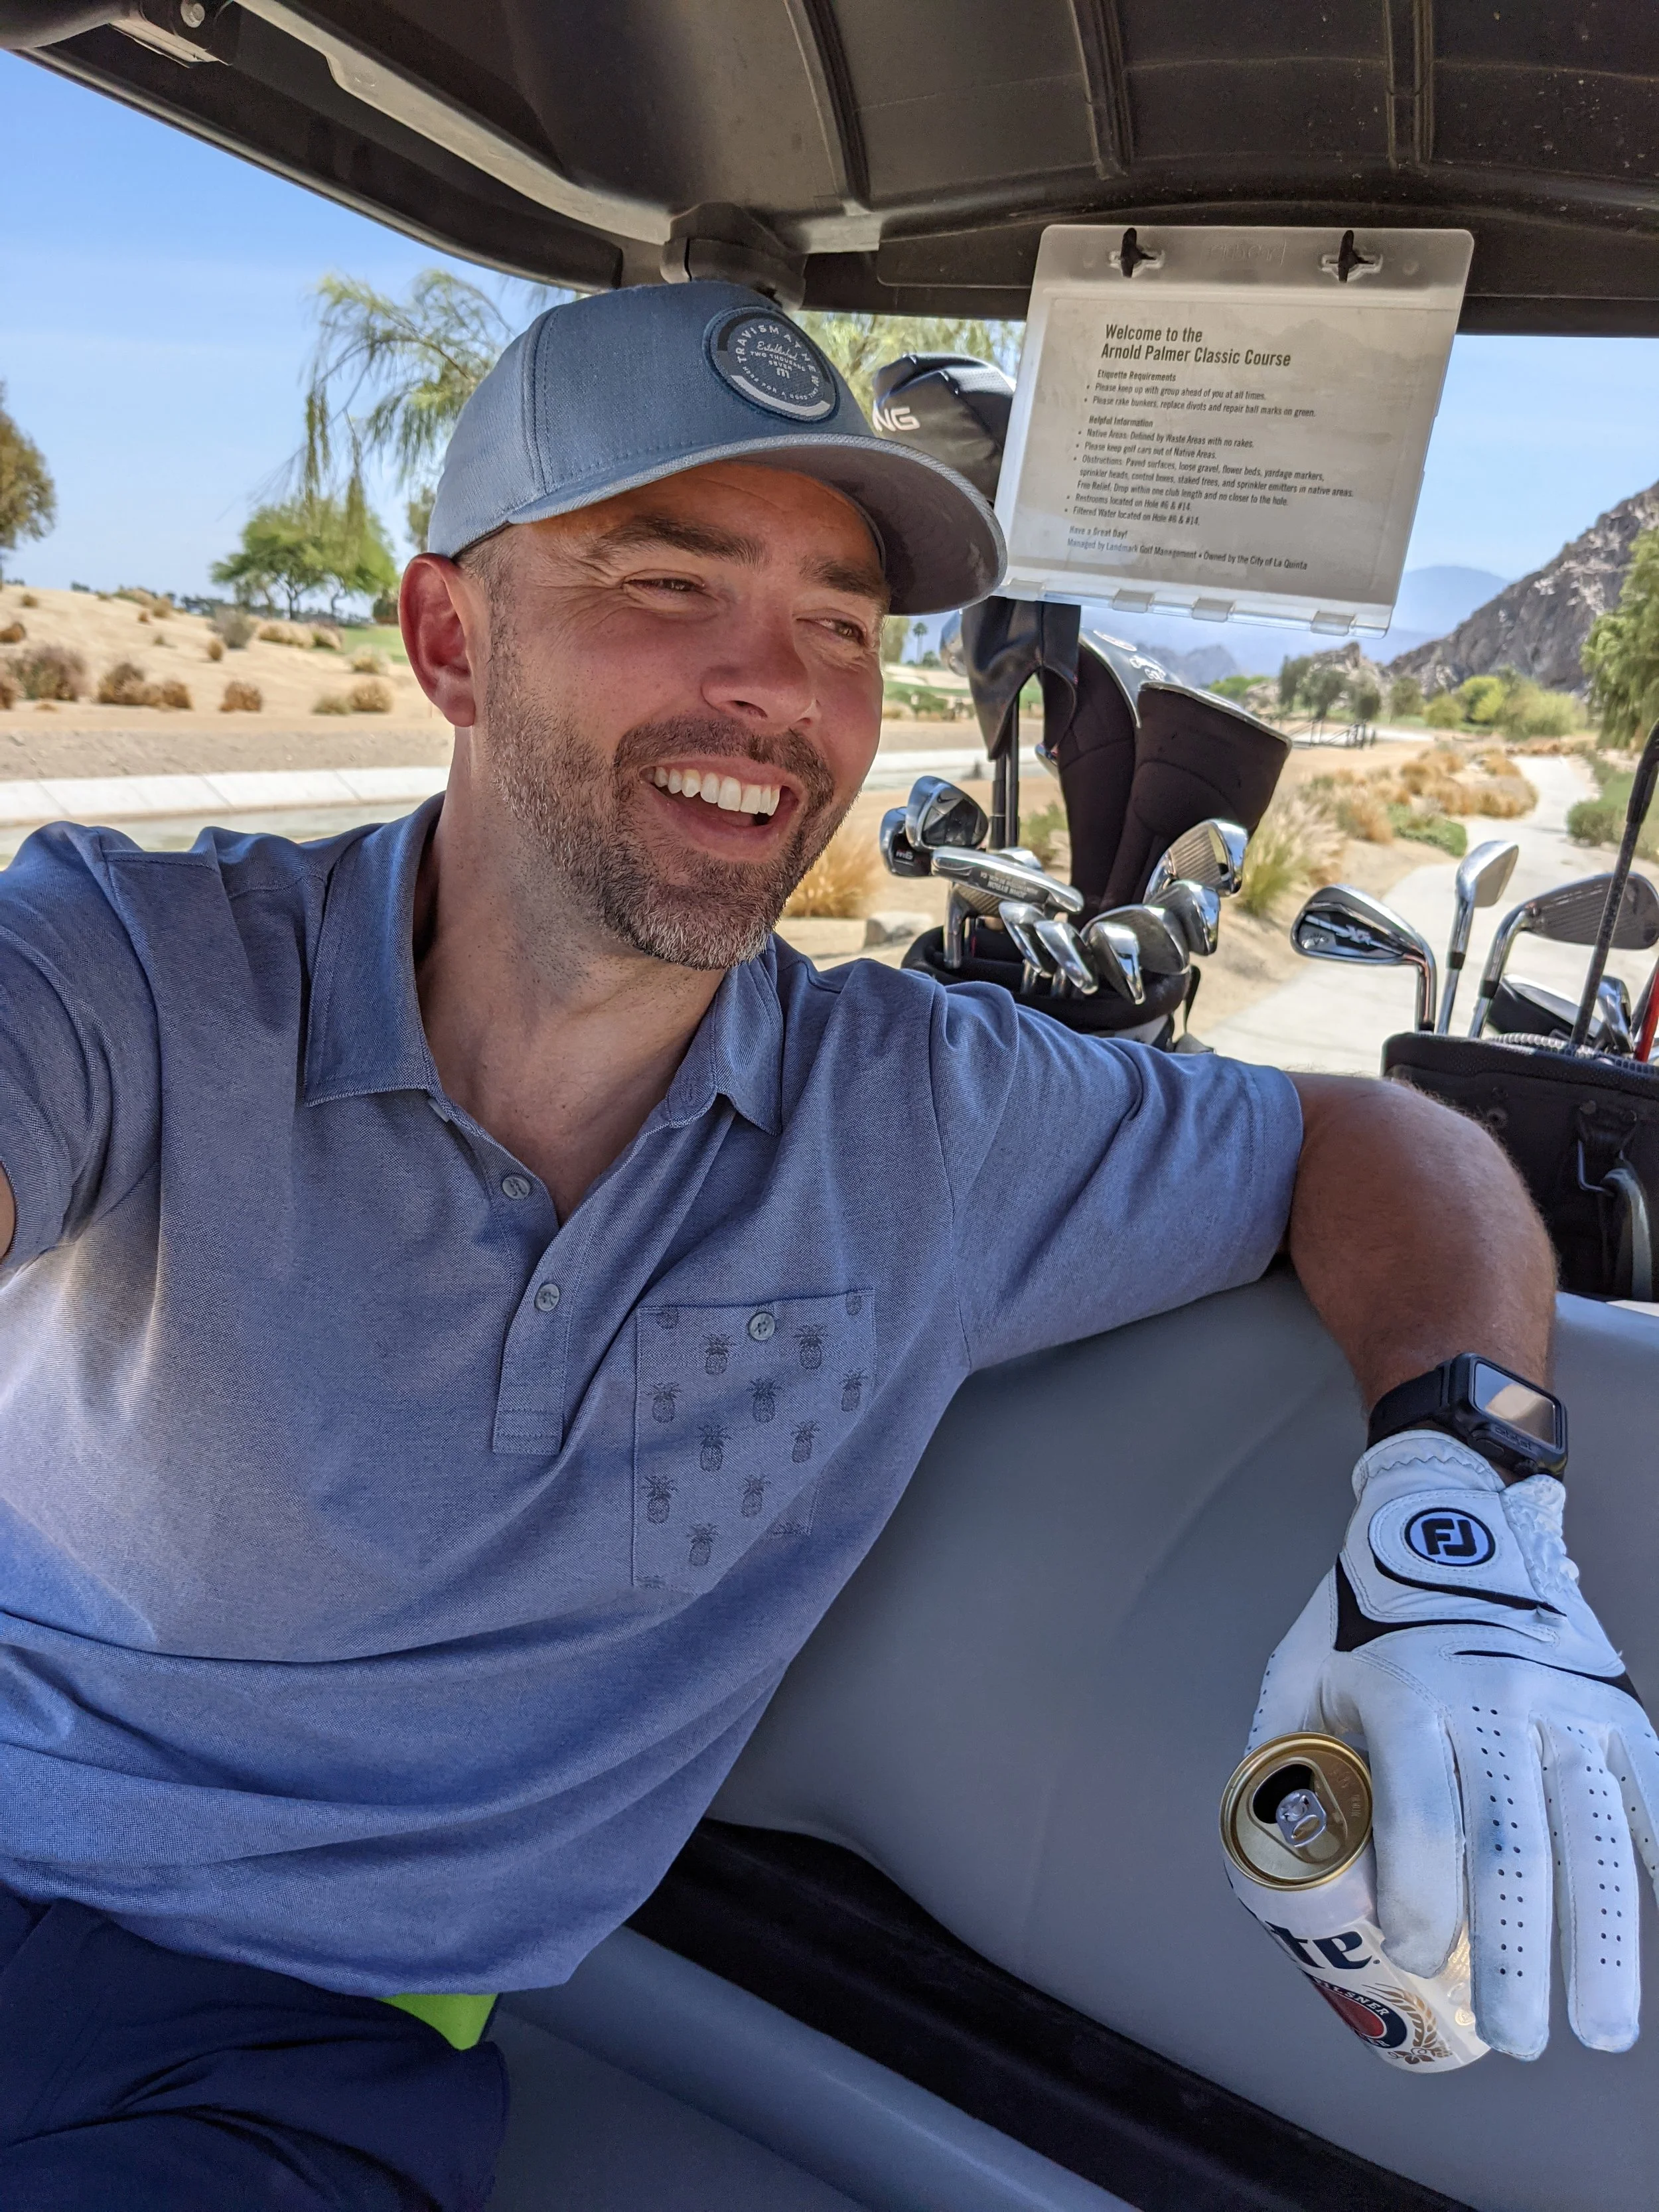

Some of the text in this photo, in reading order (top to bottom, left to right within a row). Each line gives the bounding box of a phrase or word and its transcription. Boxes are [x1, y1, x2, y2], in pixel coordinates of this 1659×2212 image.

[1106, 324, 1202, 342] Welcome to the
[1101, 343, 1291, 366] Arnold Palmer Classic Course
[1098, 369, 1176, 382] Etiquette Requirements
[1095, 383, 1116, 392] Please
[1118, 384, 1133, 394] keep
[1144, 386, 1159, 395] with
[1161, 388, 1179, 397] group
[1181, 388, 1202, 398] ahead
[1203, 388, 1211, 398] of
[1212, 391, 1224, 400] you
[1225, 390, 1233, 399] at
[1234, 390, 1243, 399] all
[1093, 396, 1114, 406] Please
[1115, 397, 1129, 407] rake
[1161, 400, 1185, 409] replace
[1187, 401, 1206, 411] divots
[1208, 403, 1222, 412] and
[1223, 404, 1243, 414] repair
[1245, 405, 1259, 414] ball
[1260, 406, 1281, 415] marks
[1294, 408, 1315, 418] green.
[1088, 415, 1153, 427] Helpful Information
[1087, 429, 1108, 438] Native
[1130, 431, 1155, 441] Defined
[1156, 433, 1165, 443] by
[1165, 433, 1185, 443] Waste
[1187, 435, 1206, 445] Areas
[1208, 437, 1222, 446] with
[1084, 441, 1216, 459] Please keep golf cars out of Native Areas.
[1126, 457, 1146, 468] Paved
[1179, 461, 1196, 472] loose
[1222, 465, 1242, 475] flower
[1264, 469, 1293, 480] yardage
[1294, 471, 1325, 482] markers,
[1080, 469, 1108, 479] sprinkler
[1131, 472, 1154, 482] control
[1178, 475, 1200, 486] staked
[1222, 479, 1236, 488] and
[1236, 480, 1267, 490] sprinkler
[1268, 482, 1297, 493] emitters
[1299, 485, 1306, 494] in
[1308, 486, 1331, 495] native
[1075, 493, 1108, 504] Restrooms
[1110, 496, 1133, 506] located
[1144, 498, 1159, 509] Hole
[1114, 483, 1129, 494] Drop
[1130, 485, 1151, 494] within
[1152, 487, 1163, 496] one
[1165, 488, 1179, 497] club
[1181, 489, 1202, 500] length
[1204, 491, 1217, 501] and
[1228, 493, 1249, 503] closer
[1251, 494, 1258, 504] to
[1260, 495, 1271, 504] the
[1073, 506, 1096, 516] Filtered
[1098, 508, 1116, 518] Water
[1118, 510, 1141, 521] located
[1152, 513, 1167, 523] Hole
[1178, 515, 1184, 524] &
[1069, 525, 1085, 535] Have
[1092, 527, 1111, 537] Great
[1067, 538, 1308, 571] Managed by Landmark Golf Management Owned by the City of La Quinta
